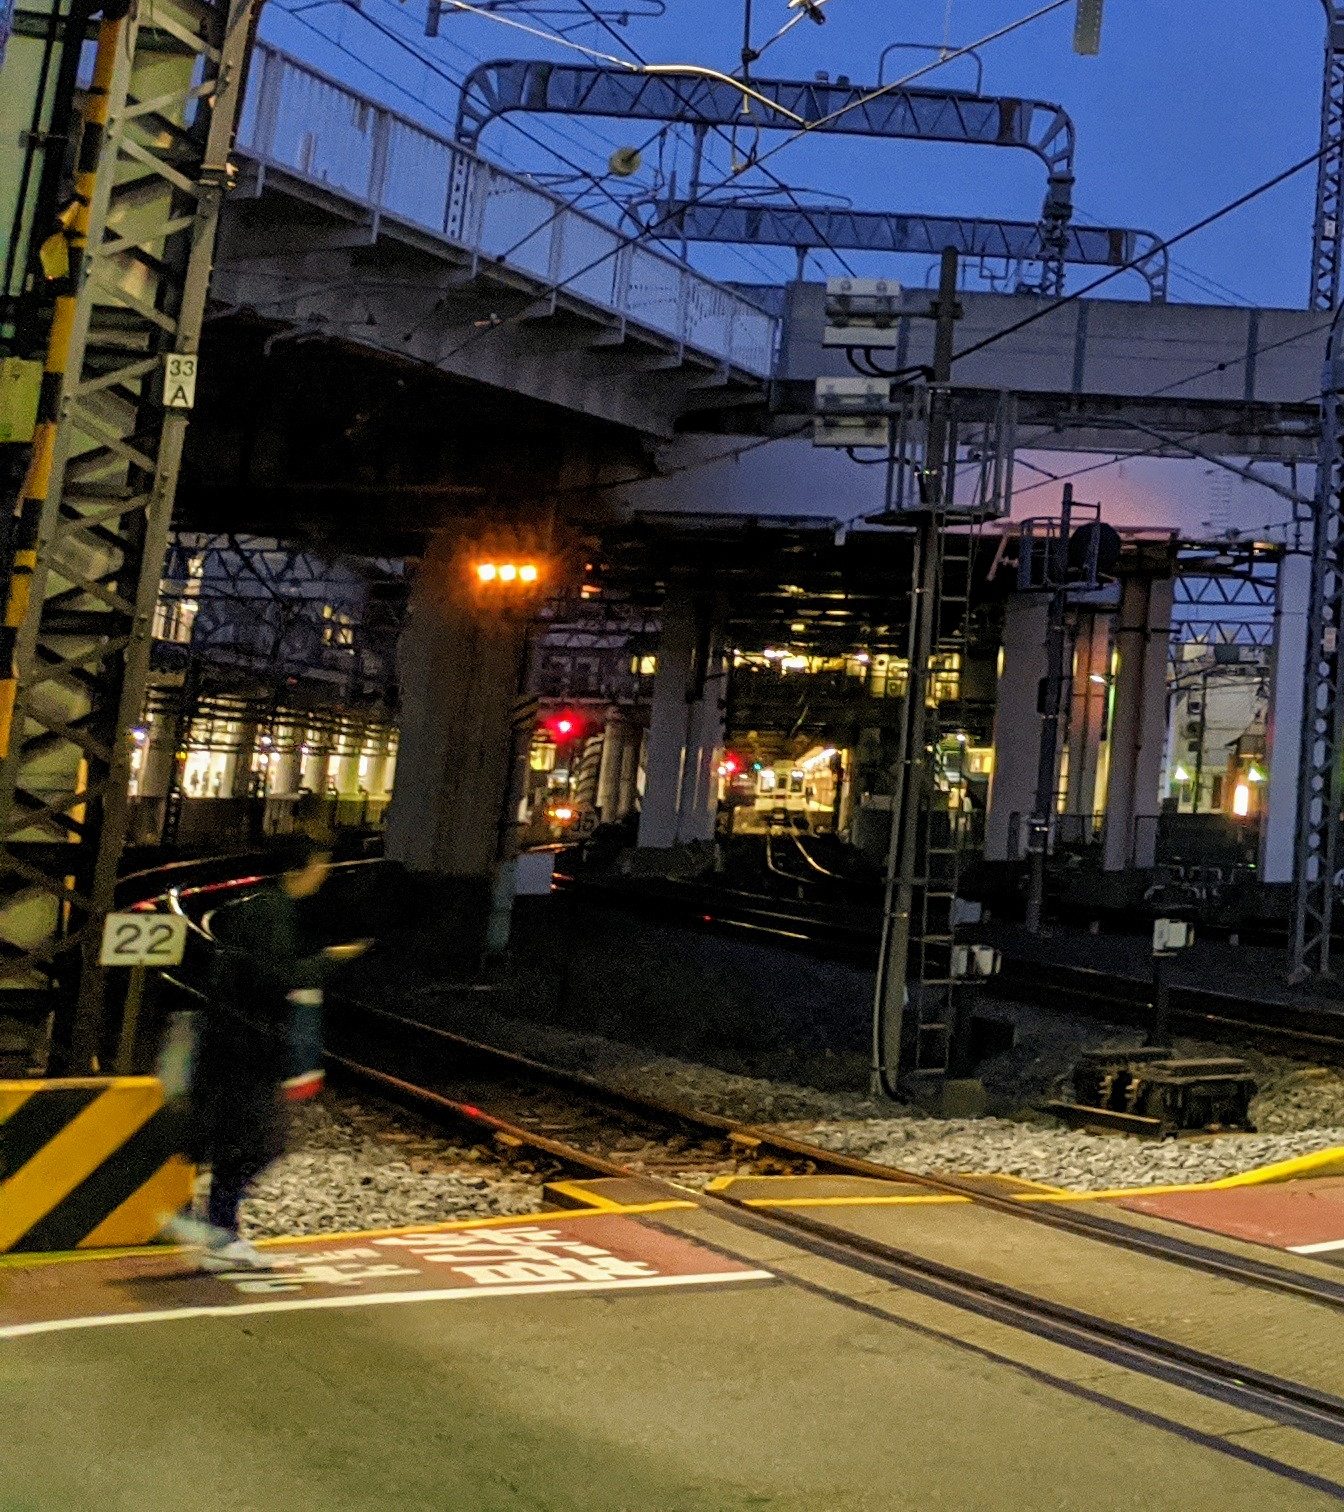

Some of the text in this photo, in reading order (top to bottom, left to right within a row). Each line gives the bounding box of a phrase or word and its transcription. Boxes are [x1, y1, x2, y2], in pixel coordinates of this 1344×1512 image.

[170, 359, 194, 377] 33
[170, 384, 189, 407] A
[114, 923, 174, 954] 22
